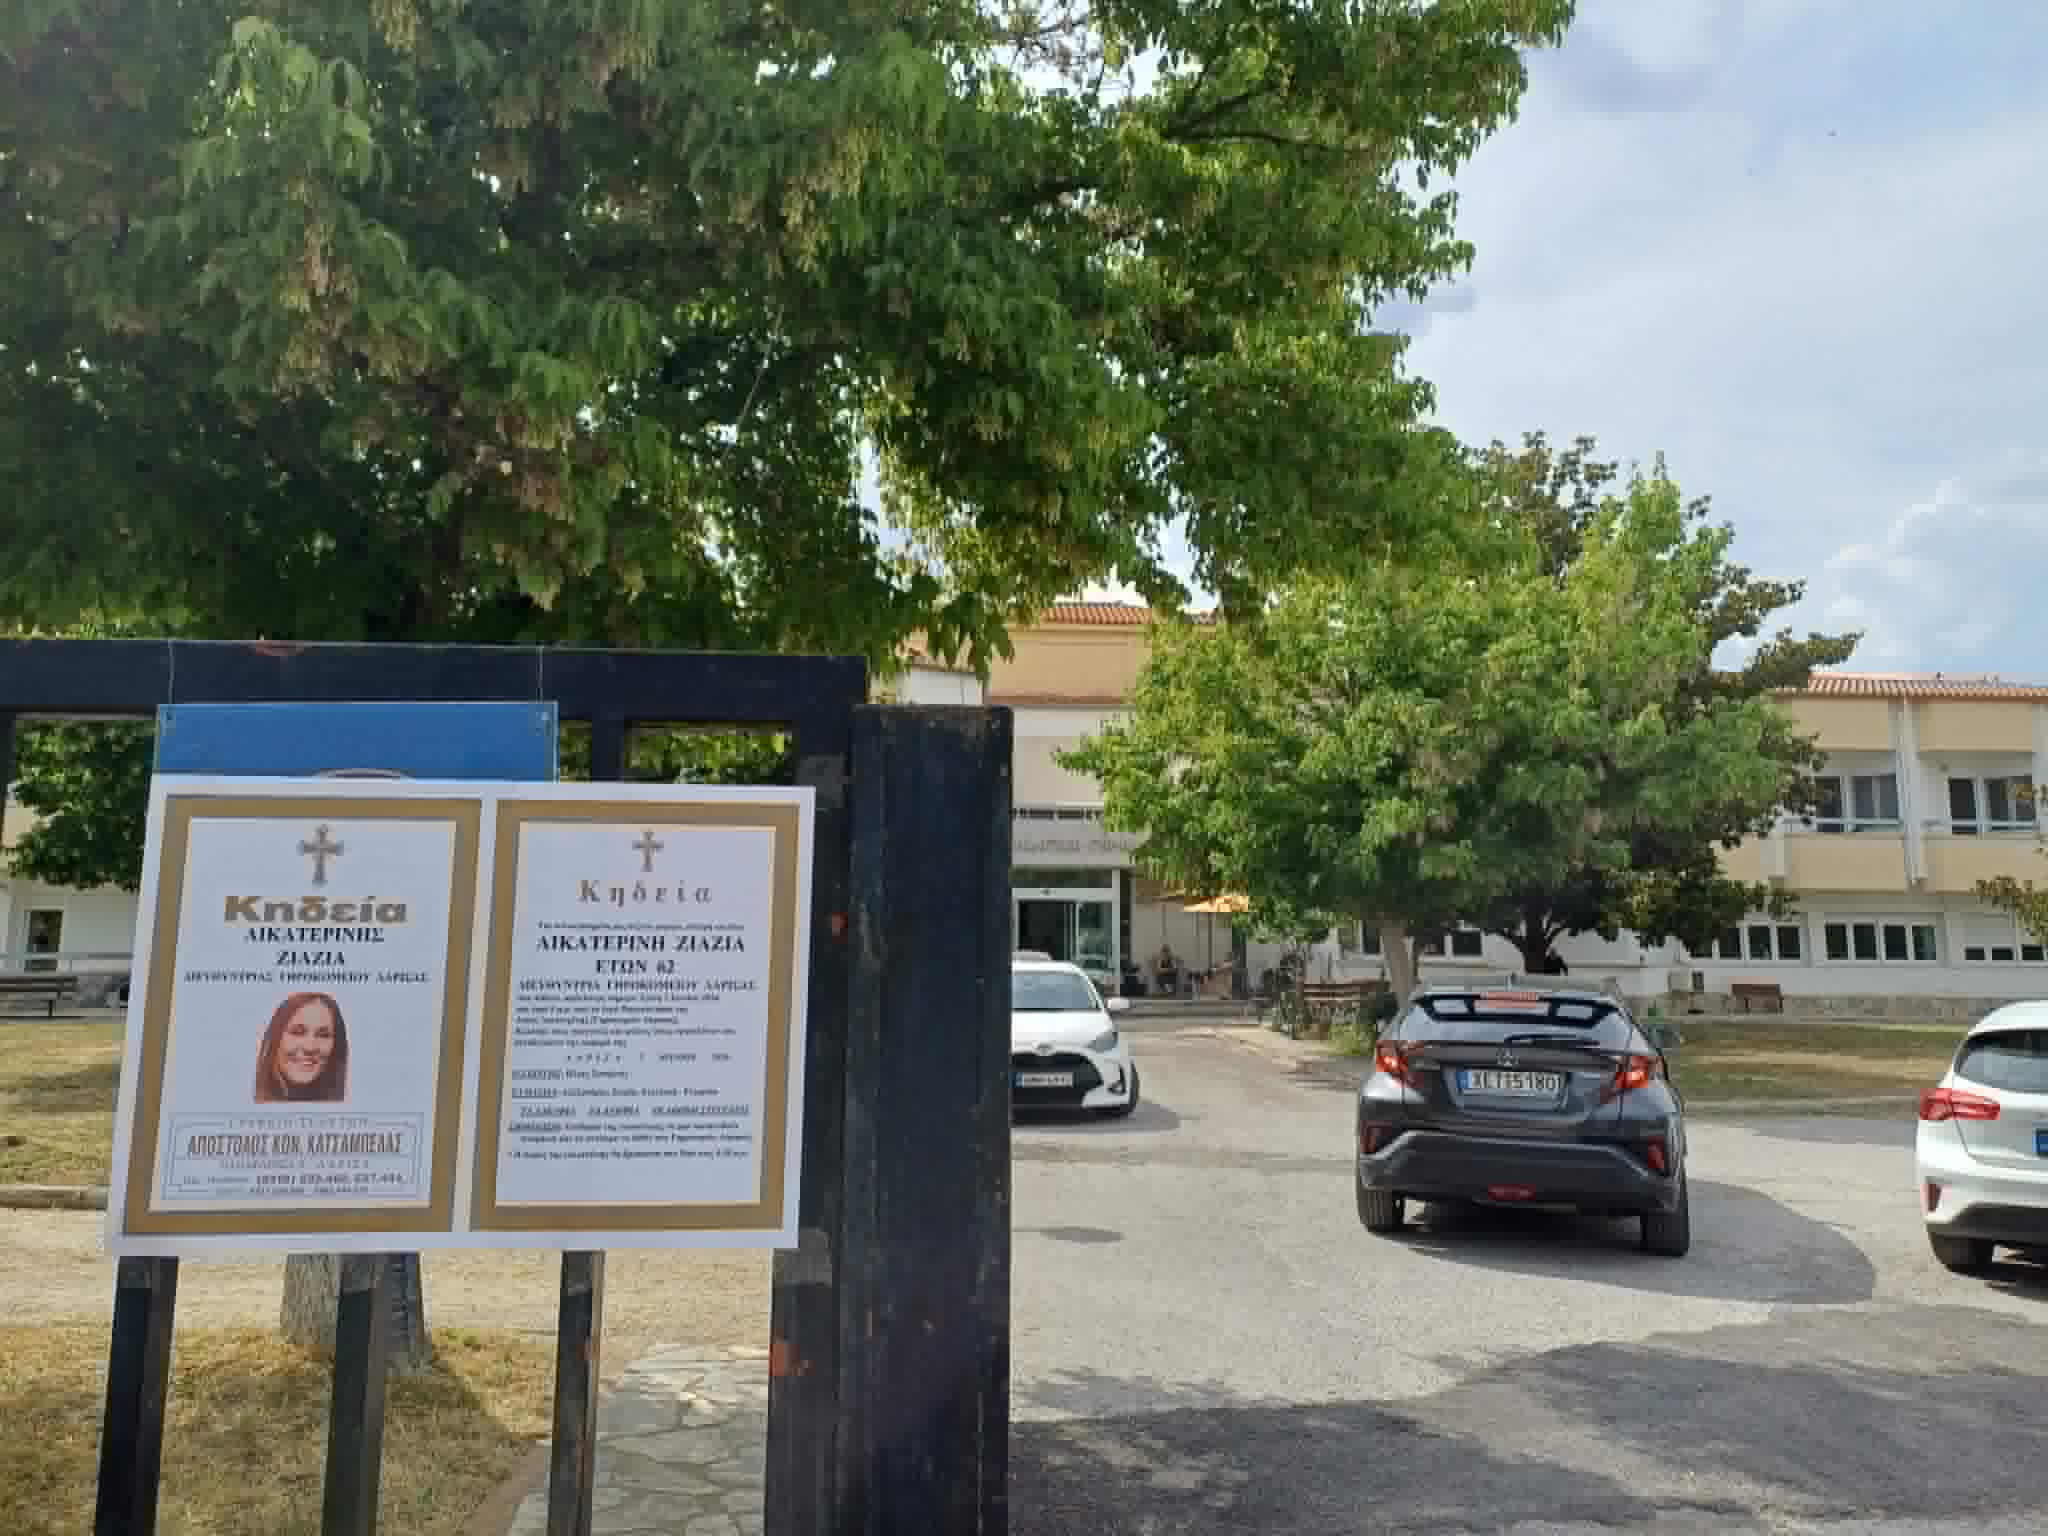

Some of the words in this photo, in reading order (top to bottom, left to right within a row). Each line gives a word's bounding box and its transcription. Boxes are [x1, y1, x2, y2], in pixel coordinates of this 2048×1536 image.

[577, 879, 712, 907] Κηδεία
[224, 895, 407, 923] Κηδεία
[245, 927, 386, 943] ΑΙΚΑΤΕΡΙΝΗΣ
[536, 935, 665, 953] ΑΙΚΑΤΕΡΙΝΗ
[672, 936, 746, 954] ΖΙΑΖΙΑ
[276, 951, 346, 966] ΖΙΑΖΙΑ
[595, 959, 648, 975] ΕΤΩΝ
[187, 1134, 269, 1158] ΑΠΟΣΤΟΛΟΣ
